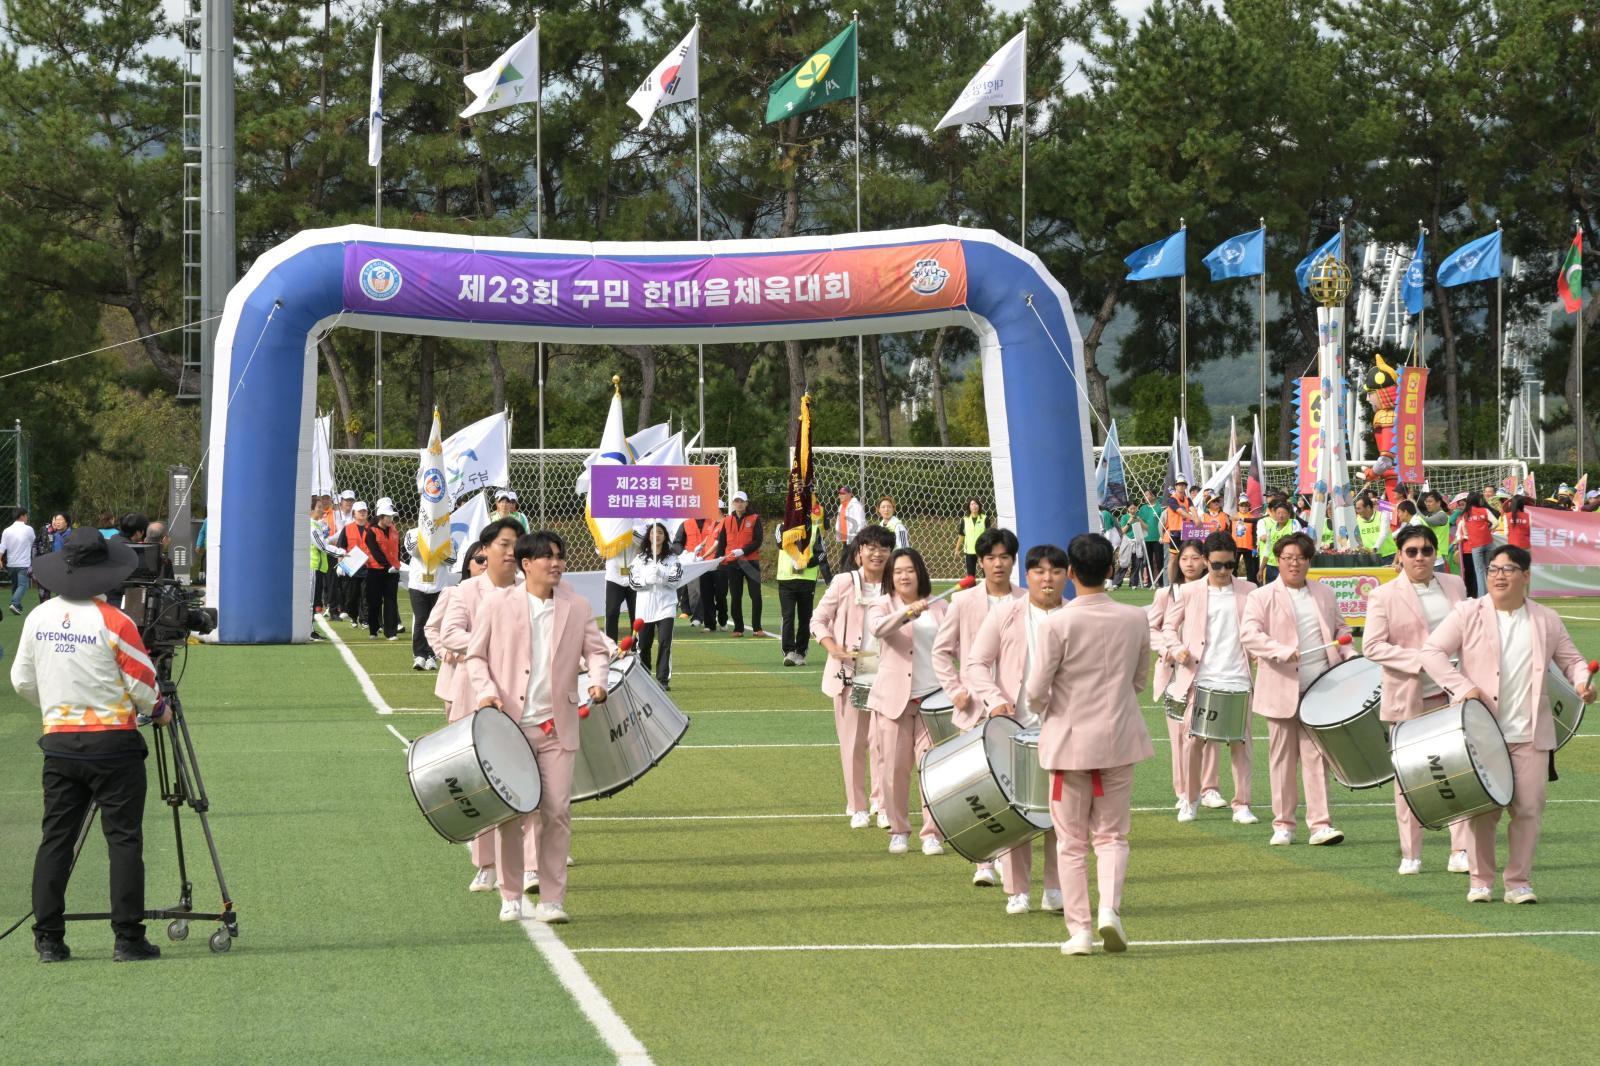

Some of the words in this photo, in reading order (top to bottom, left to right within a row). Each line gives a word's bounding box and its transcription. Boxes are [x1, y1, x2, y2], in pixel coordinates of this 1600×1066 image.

[458, 274, 559, 307] 제23회
[573, 279, 630, 308] 구민
[643, 271, 850, 308] 한마음체육대회
[616, 477, 661, 490] 제23회
[667, 477, 693, 490] 구민
[608, 495, 701, 508] 한마음체육대회
[36, 632, 97, 645] GYEONGNAM
[55, 643, 76, 653] 2025
